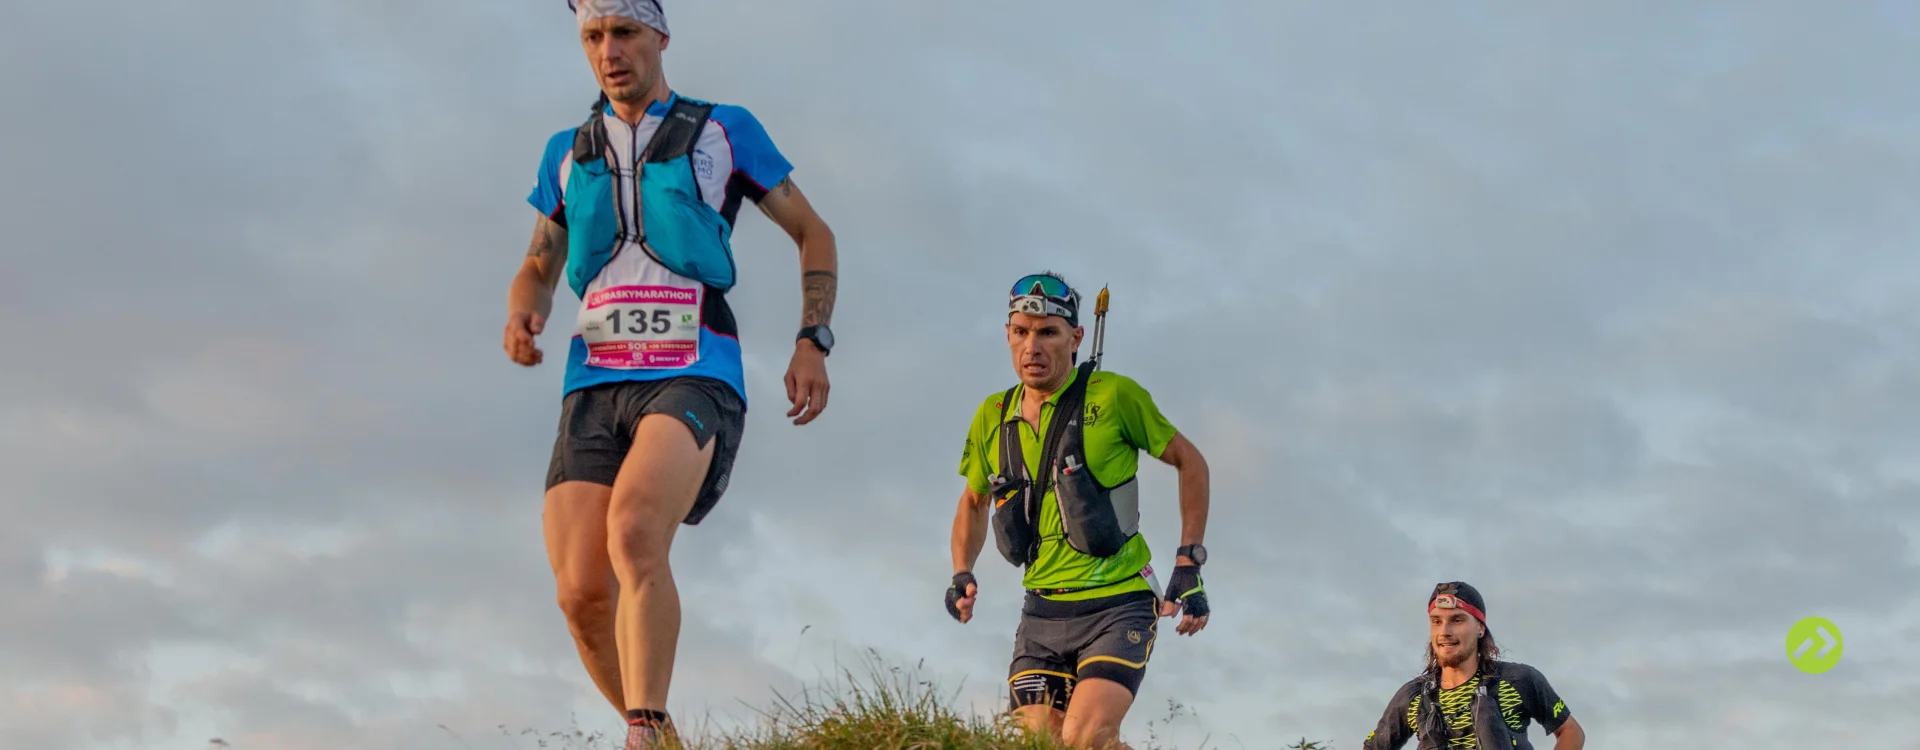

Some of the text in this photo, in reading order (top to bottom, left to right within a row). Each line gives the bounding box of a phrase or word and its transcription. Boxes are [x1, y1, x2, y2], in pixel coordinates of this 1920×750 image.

[591, 289, 692, 305] ULTRASKYMARATHON
[606, 309, 671, 334] 135
[628, 342, 648, 351] SOS
